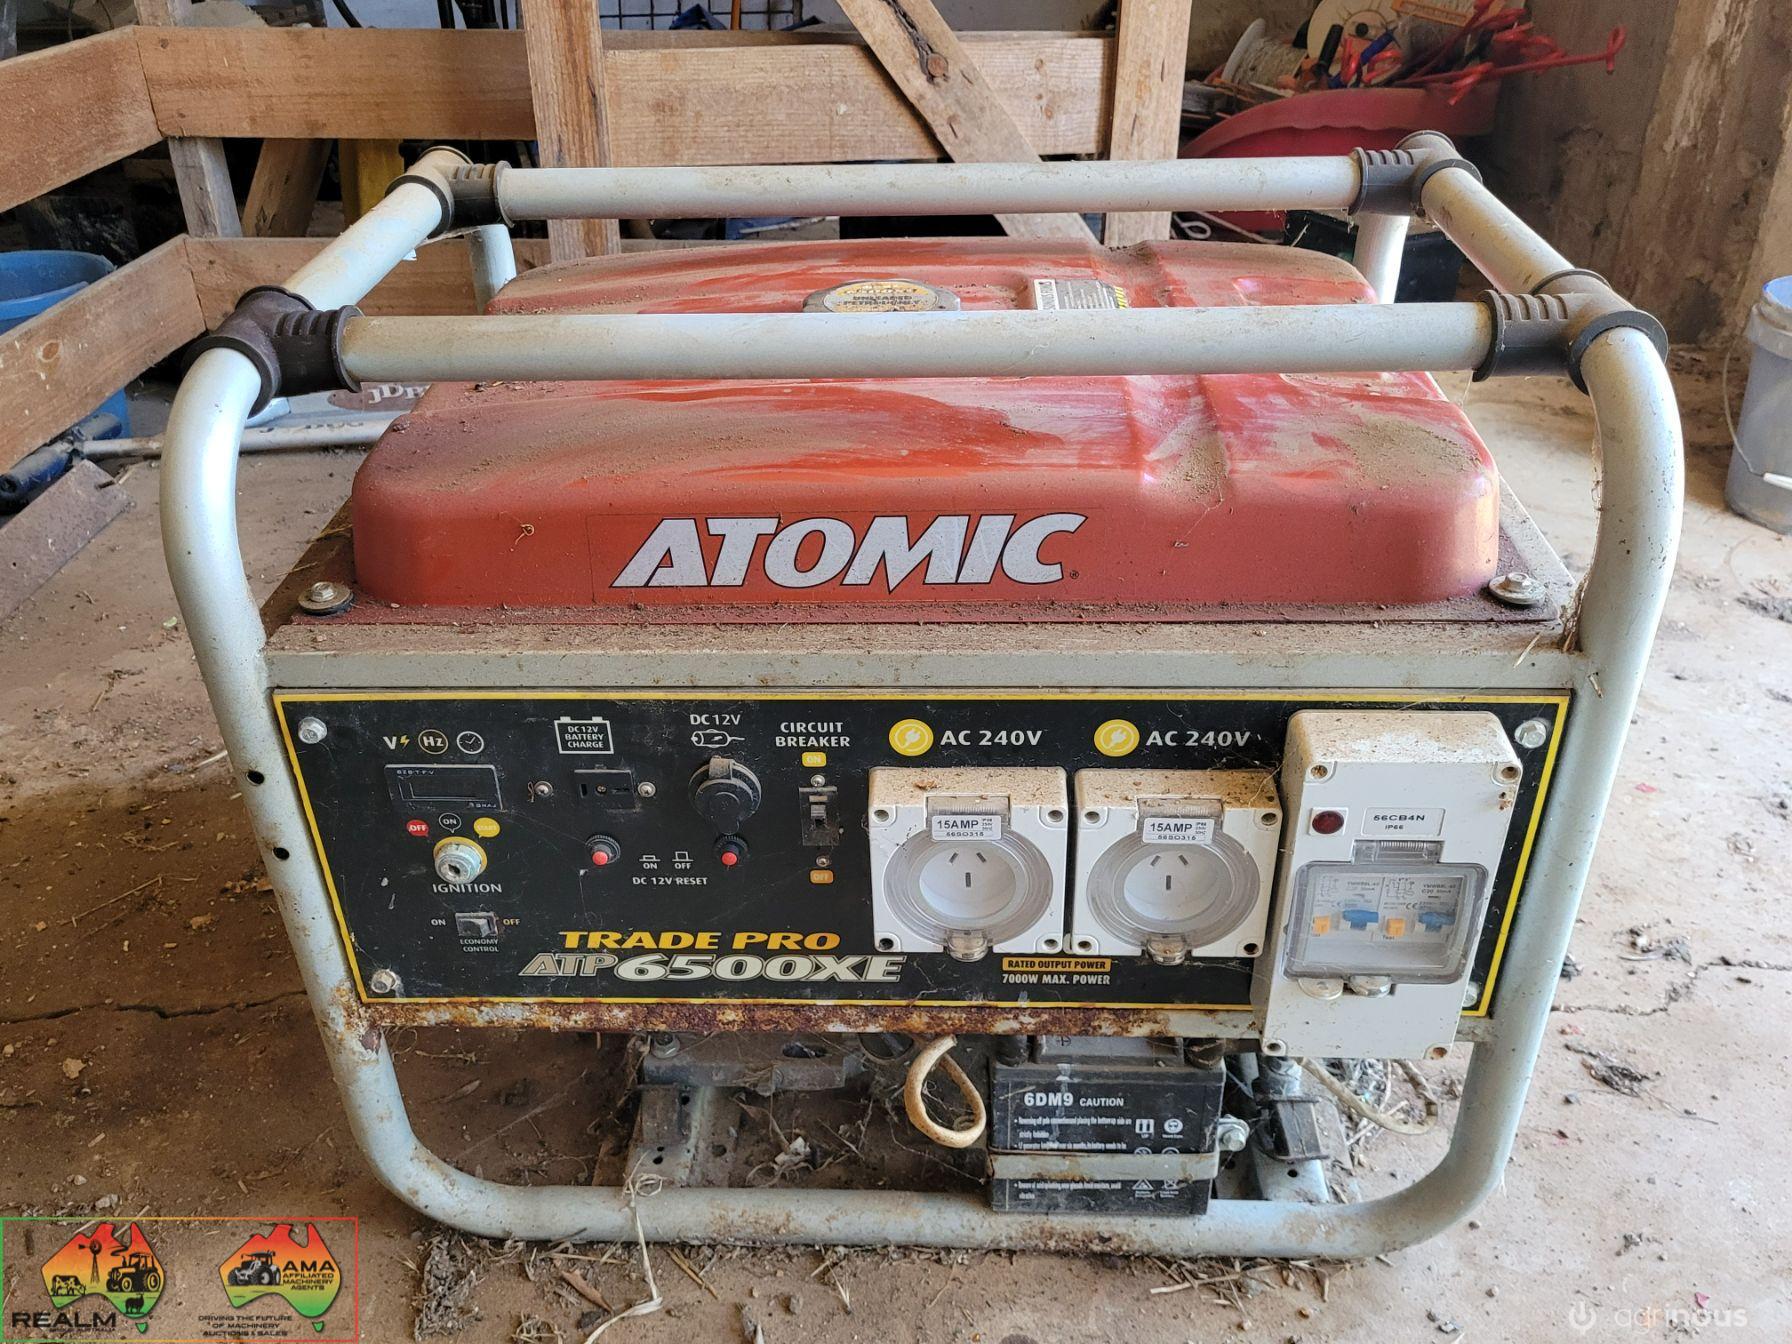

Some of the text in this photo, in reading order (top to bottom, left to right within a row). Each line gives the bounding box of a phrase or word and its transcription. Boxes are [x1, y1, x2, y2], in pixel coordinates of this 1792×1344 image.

[609, 511, 1088, 595] ATOMIC
[780, 722, 843, 733] CIRCUIT
[382, 736, 397, 749] V
[422, 736, 444, 746] Hz
[775, 736, 850, 747] BREAKER
[940, 730, 1042, 746] AC 240V
[1146, 731, 1250, 746] AC 240V
[408, 824, 427, 832] OFF
[937, 820, 979, 829] 15AMP
[1150, 823, 1193, 832] 15AMP
[643, 862, 658, 870] ON
[674, 862, 691, 870] OFF
[632, 877, 708, 885] DC 12V RESET
[432, 883, 502, 893] IGNITION
[430, 918, 446, 926] ON
[503, 918, 521, 926] OFF
[558, 931, 841, 951] TRADE PRO
[1007, 960, 1106, 969] RATED OUTPUT POWER
[1002, 974, 1110, 985] 7000W MAX. POWER
[1024, 1092, 1124, 1107] 6DM9 CAUTION
